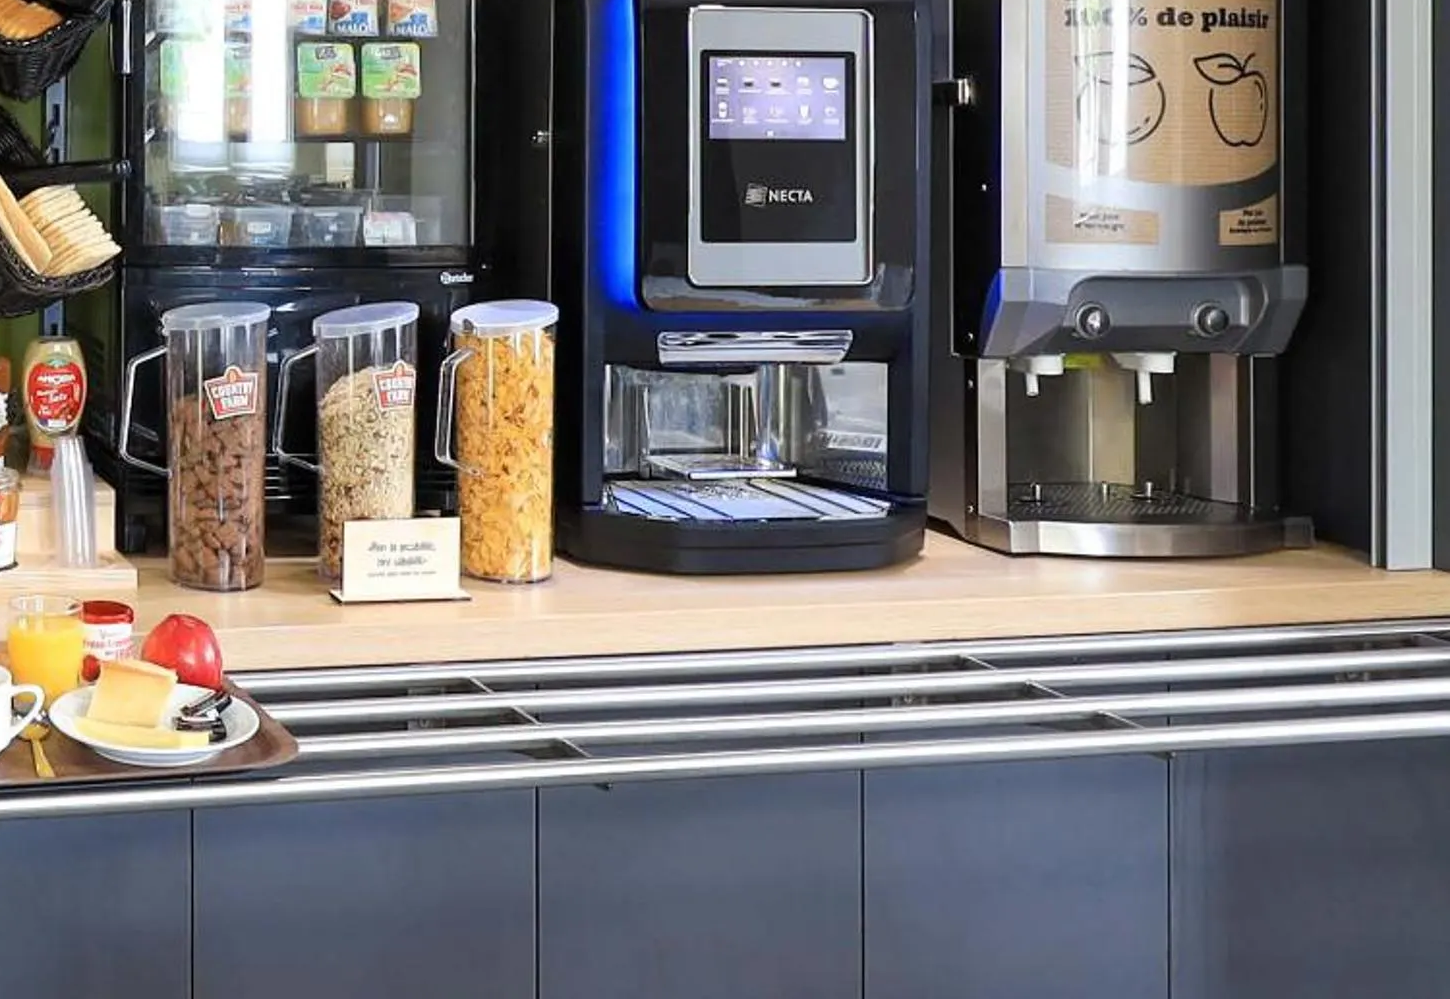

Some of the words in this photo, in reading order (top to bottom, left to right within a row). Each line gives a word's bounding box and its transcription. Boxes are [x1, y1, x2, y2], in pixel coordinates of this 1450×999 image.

[1156, 7, 1195, 27] de
[1200, 8, 1270, 33] plaisir
[768, 188, 814, 203] NECTA
